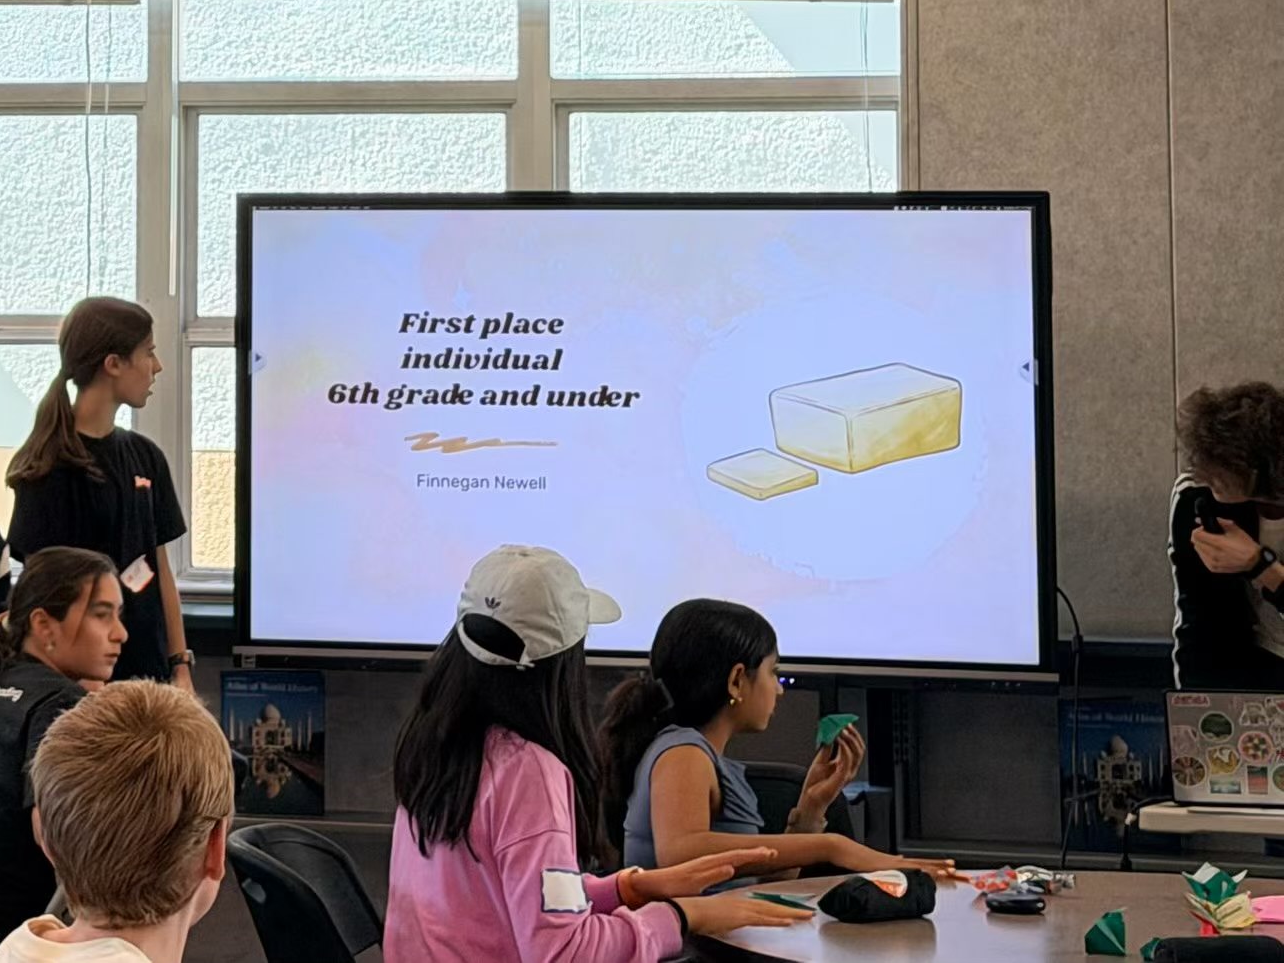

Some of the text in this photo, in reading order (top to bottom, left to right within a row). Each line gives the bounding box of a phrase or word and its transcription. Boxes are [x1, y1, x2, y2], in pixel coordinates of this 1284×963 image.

[398, 311, 564, 339] First place
[400, 346, 564, 370] individual
[327, 382, 640, 410] 6th grade and under
[416, 474, 547, 491] Finnegan Newell
